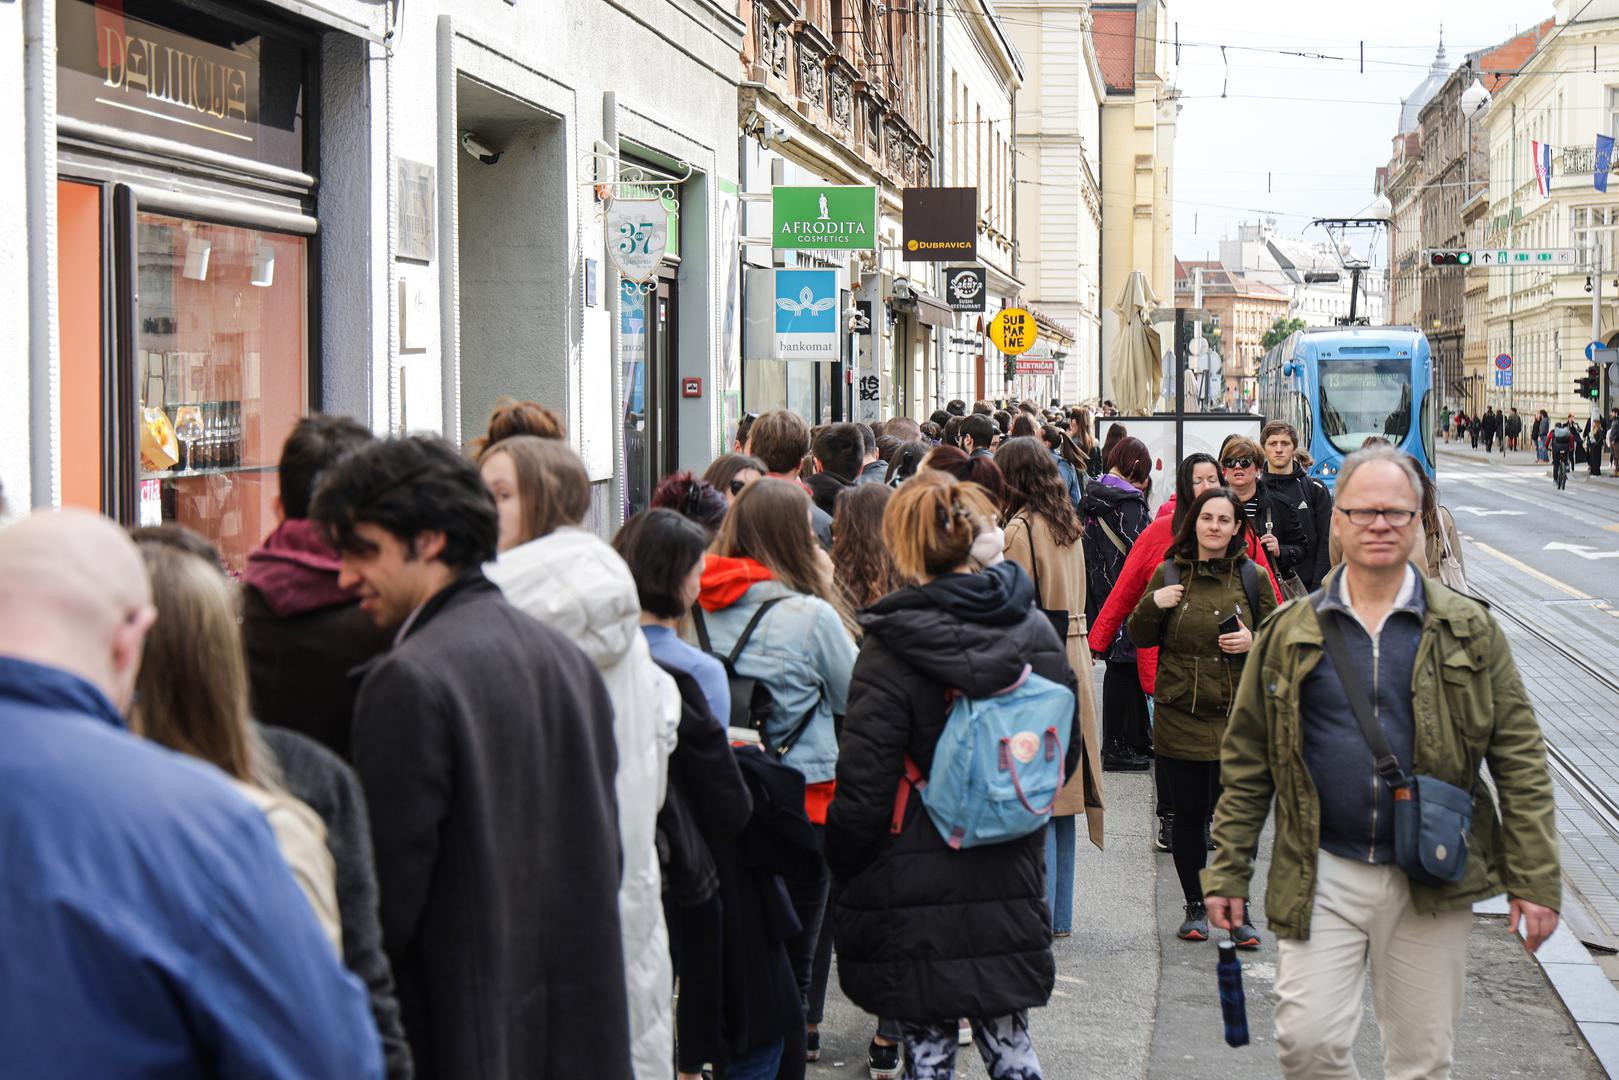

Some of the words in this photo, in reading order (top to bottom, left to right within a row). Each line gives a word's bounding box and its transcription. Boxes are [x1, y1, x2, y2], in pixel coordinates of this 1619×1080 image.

[781, 221, 865, 234] AFRODITA
[797, 235, 849, 243] COSMETICS
[919, 241, 972, 249] DUBRAVICA
[1003, 314, 1025, 325] SUB
[1003, 325, 1025, 337] MAR
[780, 341, 832, 351] bankomat
